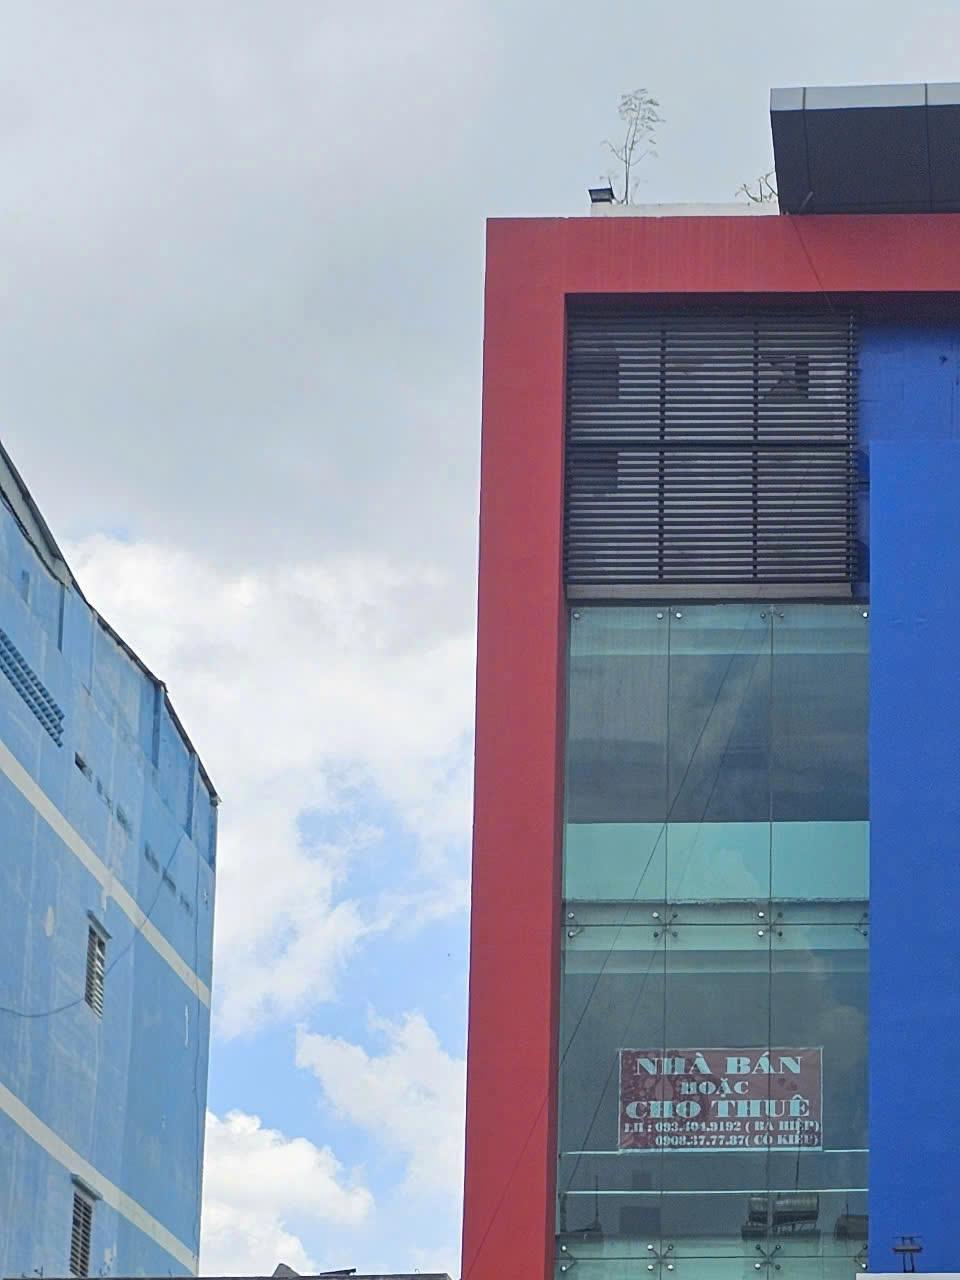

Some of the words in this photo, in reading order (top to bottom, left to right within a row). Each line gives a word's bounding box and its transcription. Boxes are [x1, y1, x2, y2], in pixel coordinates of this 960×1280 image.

[634, 1051, 713, 1076] NHÀ
[726, 1050, 803, 1075] BÁN
[680, 1078, 749, 1098] HOẶC
[625, 1100, 702, 1119] CHO
[711, 1094, 810, 1118] THUÊ
